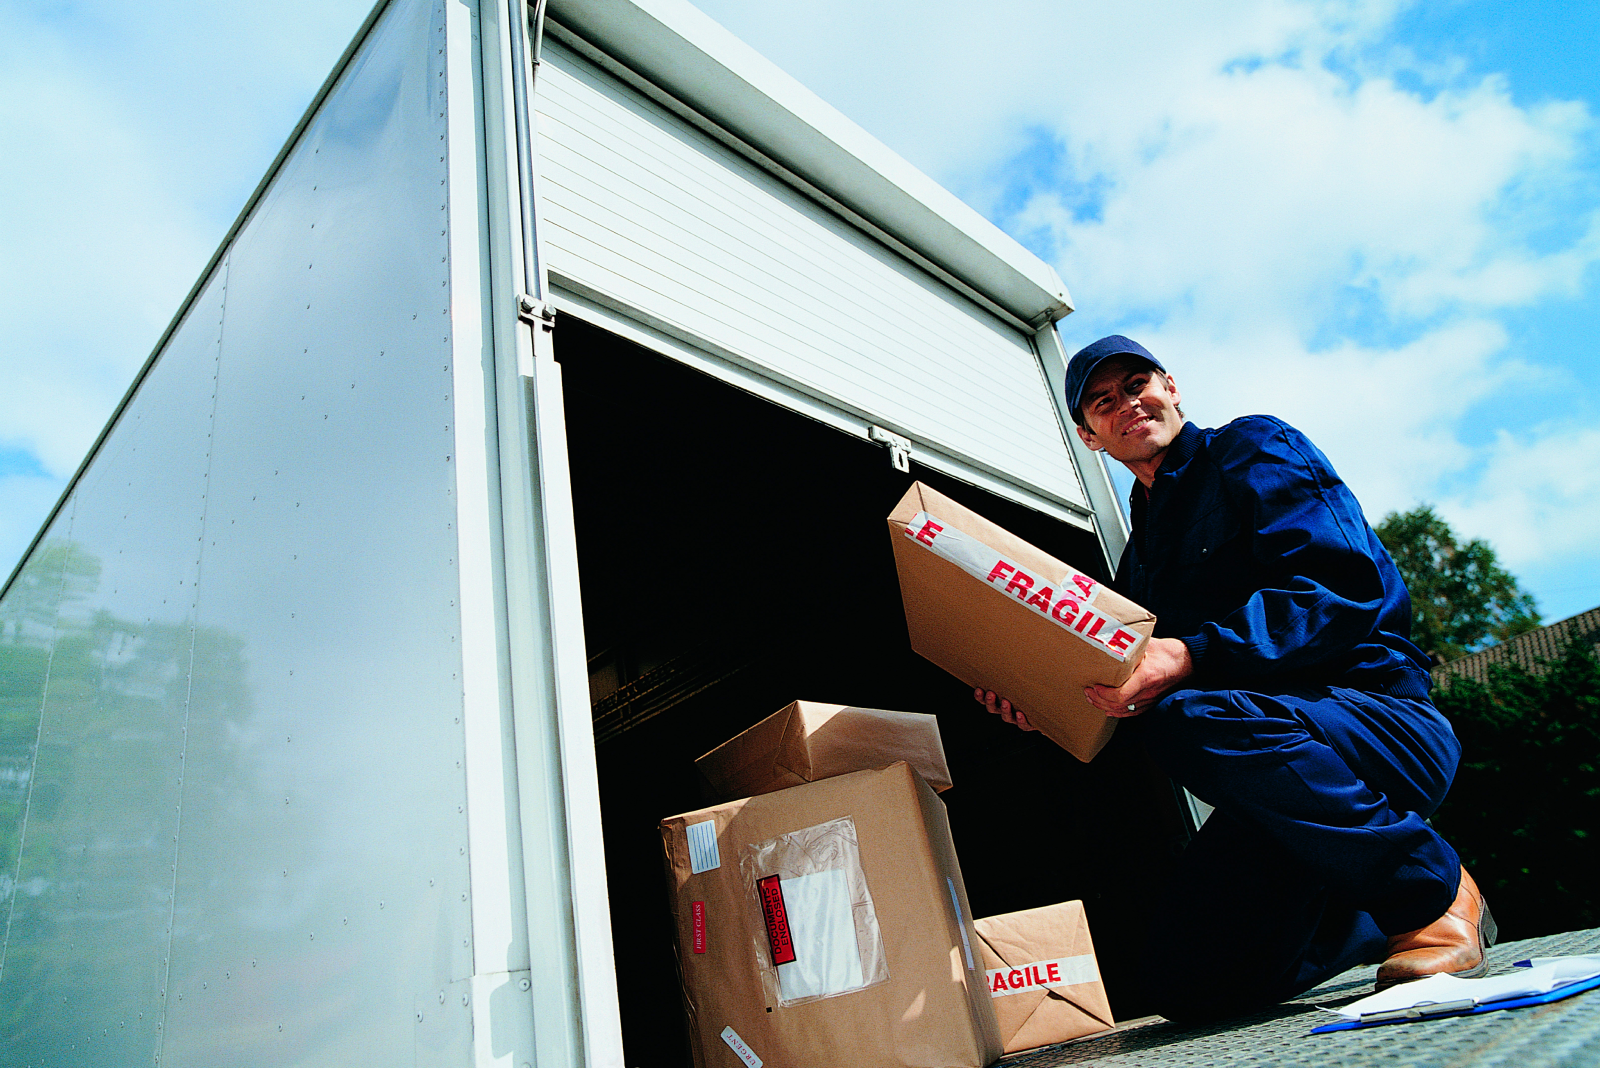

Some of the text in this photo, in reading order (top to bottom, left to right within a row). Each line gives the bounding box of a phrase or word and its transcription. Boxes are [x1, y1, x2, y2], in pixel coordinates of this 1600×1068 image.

[986, 560, 1136, 656] FRAGILE
[762, 887, 782, 955] DOCUMENTS
[771, 888, 789, 946] ENCLOSED
[986, 962, 1061, 993] AGILE
[726, 1034, 756, 1066] URGENT
